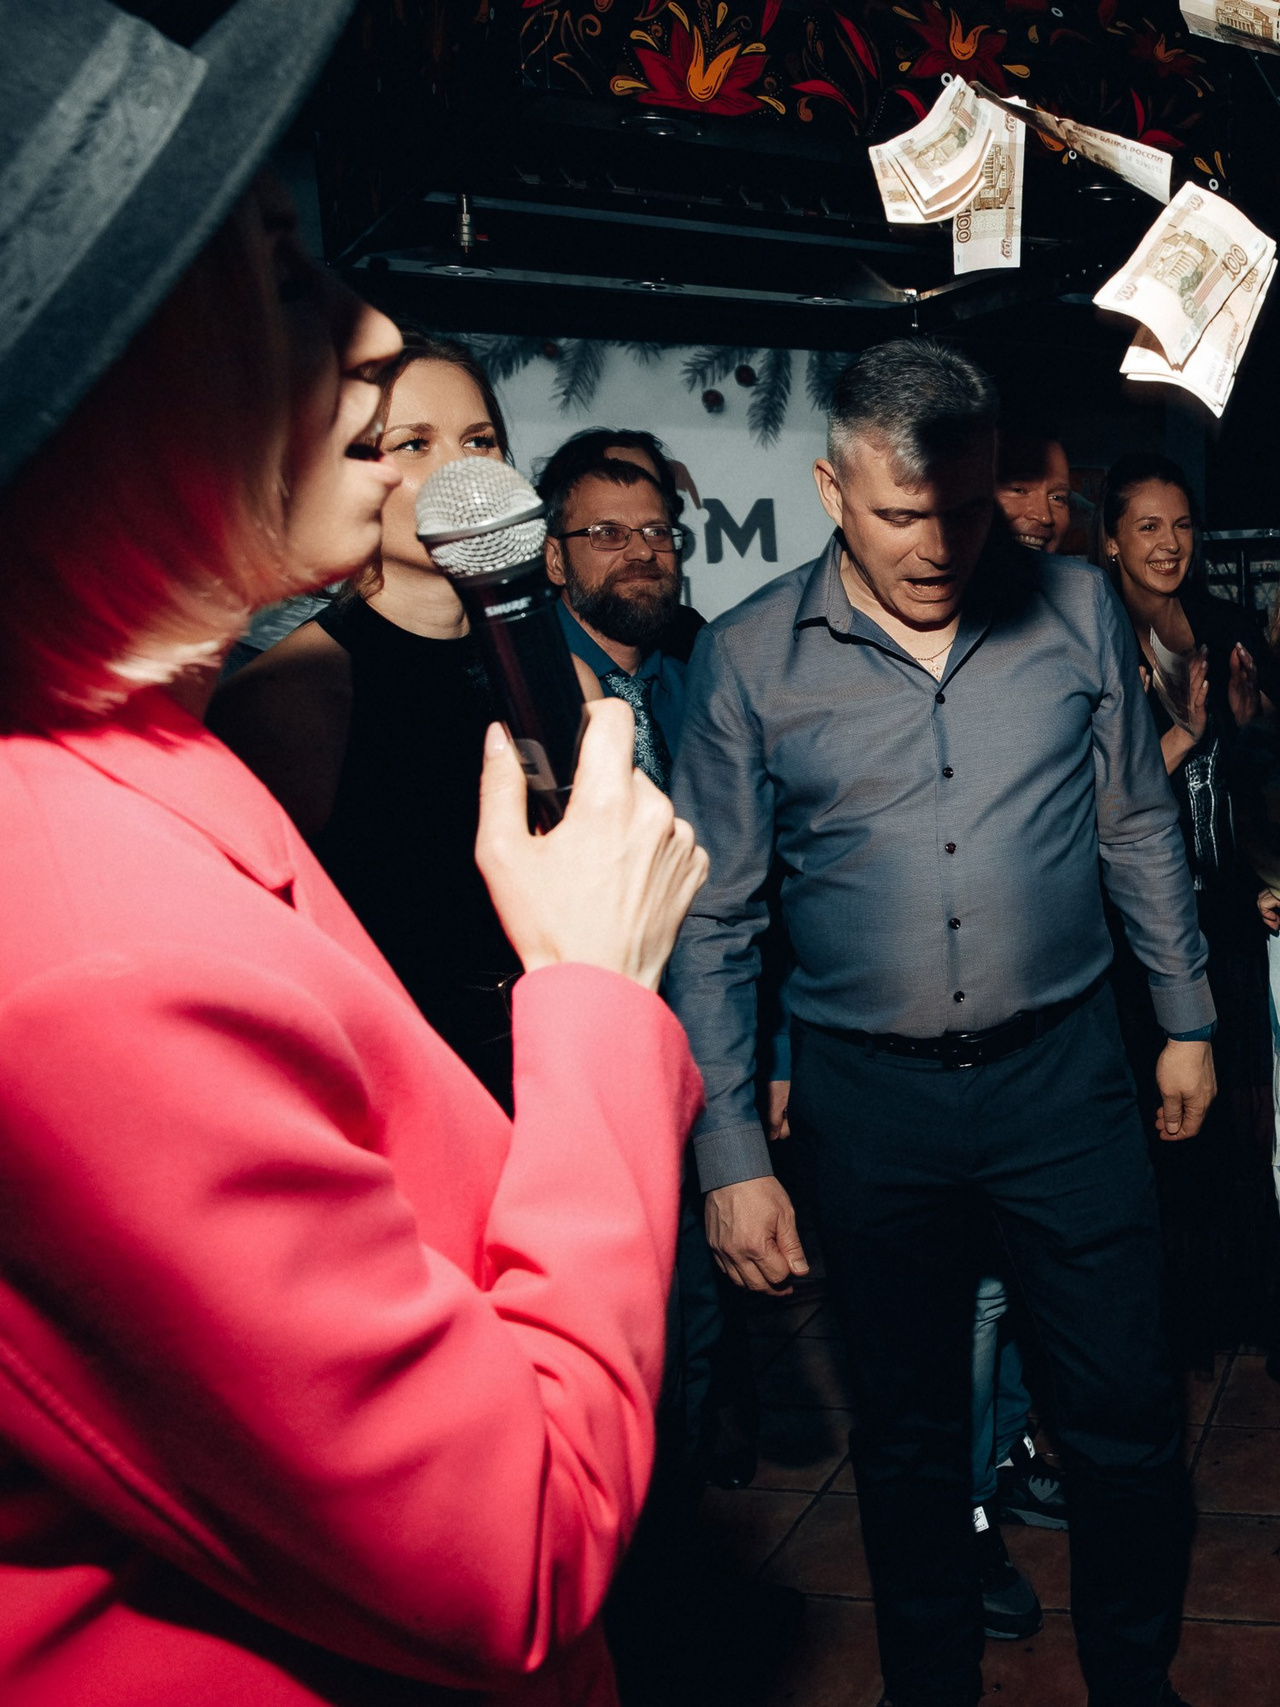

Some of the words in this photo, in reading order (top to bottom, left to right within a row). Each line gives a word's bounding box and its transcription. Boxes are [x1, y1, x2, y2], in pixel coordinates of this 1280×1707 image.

[1001, 238, 1013, 260] 100
[1222, 244, 1249, 282] 100
[483, 596, 529, 617] SHURE
